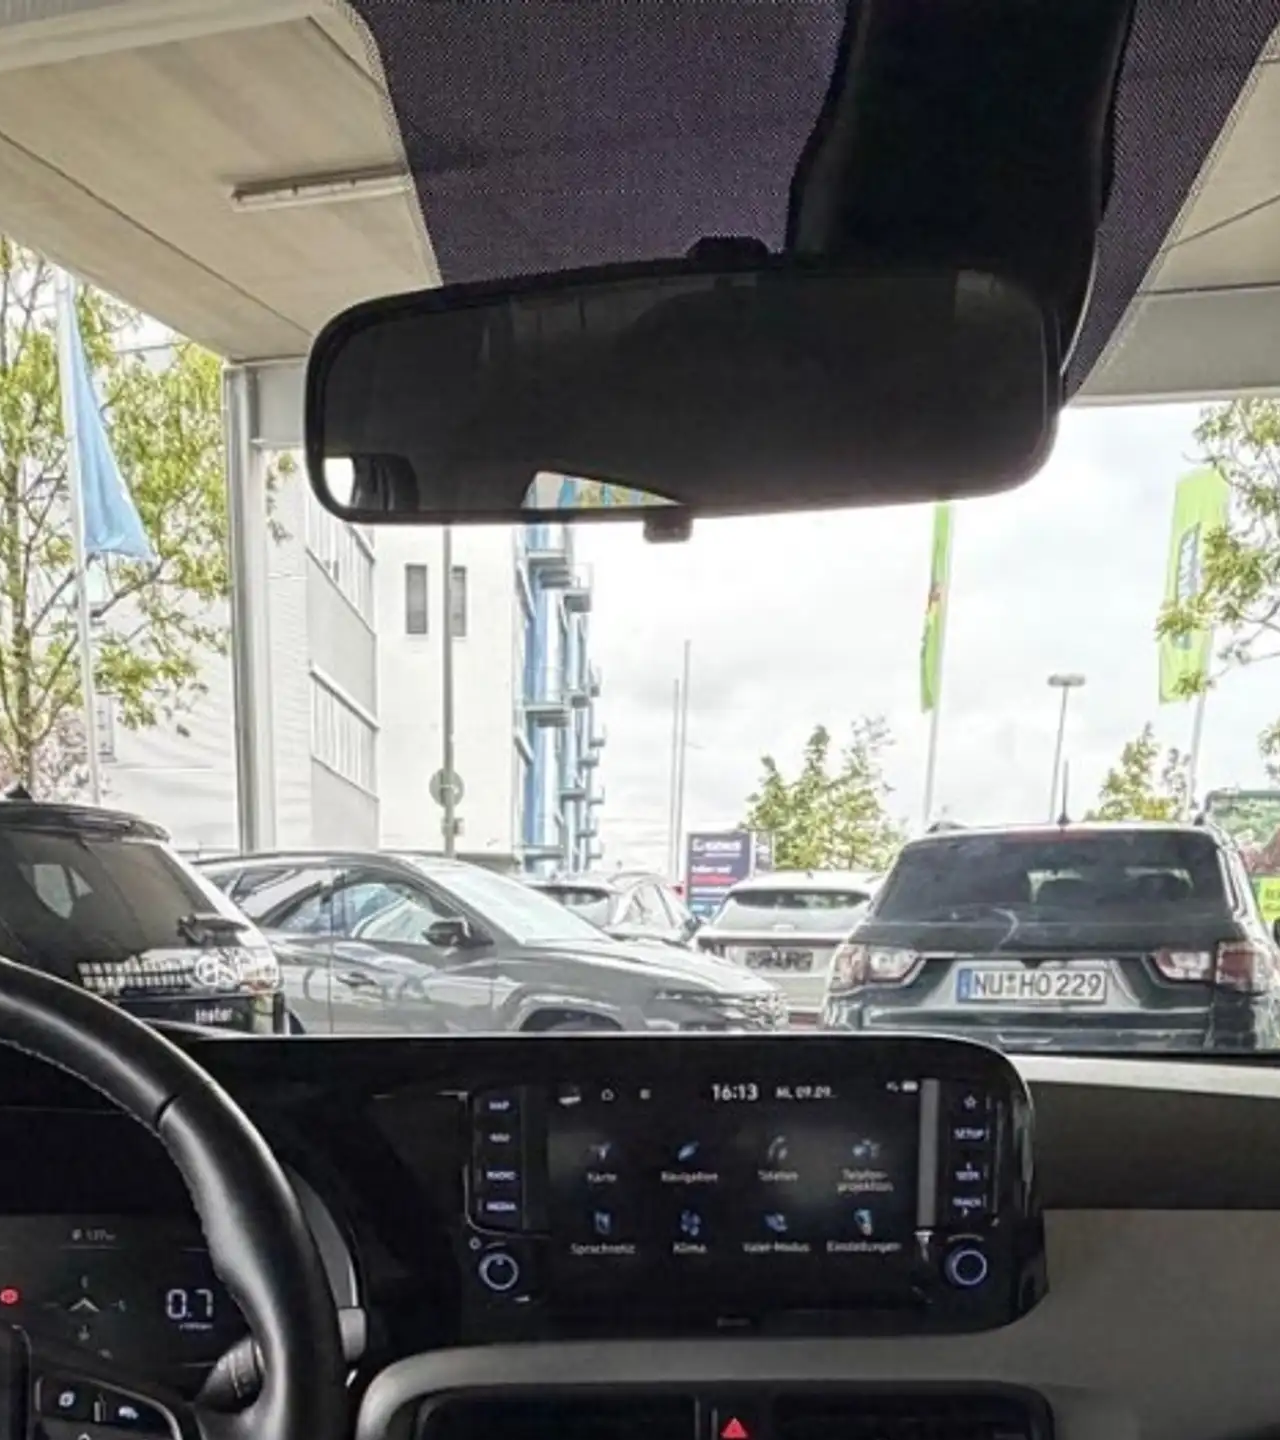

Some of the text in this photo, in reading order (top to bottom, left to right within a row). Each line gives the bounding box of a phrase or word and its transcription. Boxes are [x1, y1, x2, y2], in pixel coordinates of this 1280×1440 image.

[974, 973, 1003, 996] NU
[1056, 973, 1102, 997] 229
[711, 1083, 759, 1101] 16:13
[953, 1127, 985, 1141] SETUP
[485, 1170, 517, 1181] RADIO
[660, 1169, 719, 1184] Navigation
[166, 1288, 214, 1320] 0.7
